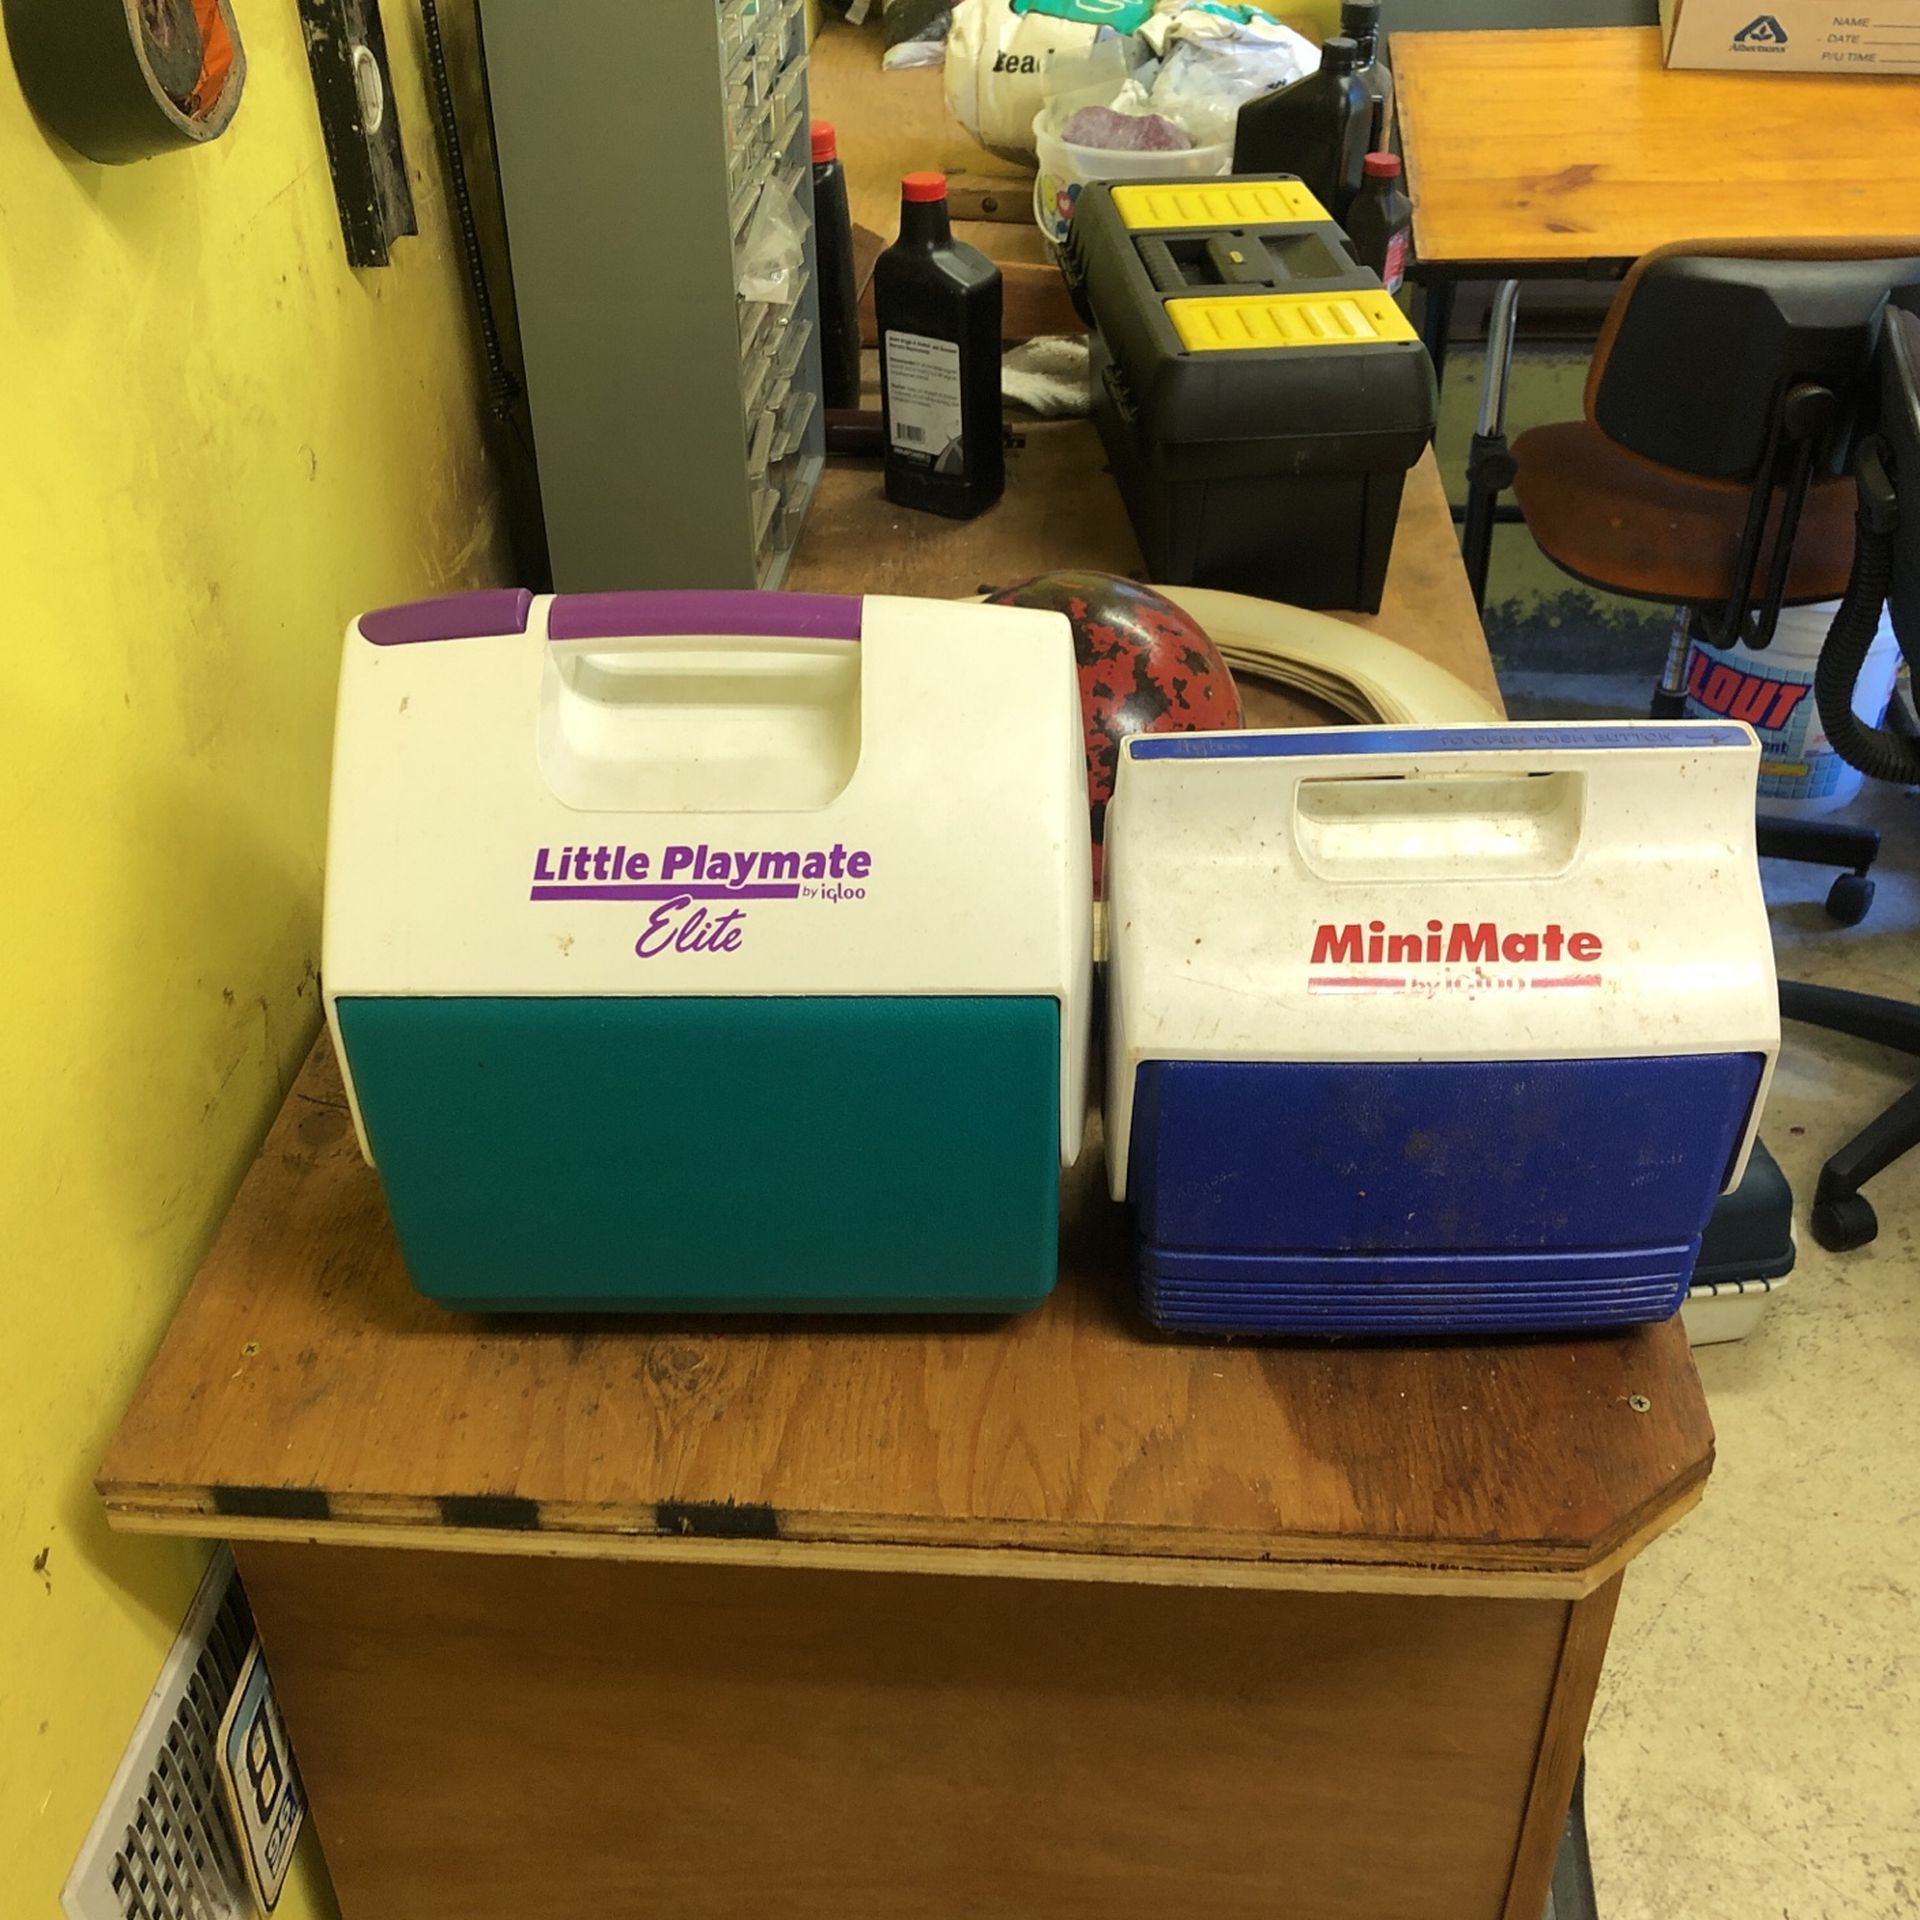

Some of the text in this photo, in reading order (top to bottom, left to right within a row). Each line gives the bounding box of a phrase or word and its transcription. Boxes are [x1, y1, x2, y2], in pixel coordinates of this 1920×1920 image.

[1832, 17, 1871, 28] NAME
[1826, 34, 1861, 44] DATE
[1848, 53, 1877, 64] TIME
[1688, 648, 1811, 731] LOUT
[534, 844, 872, 887] Little Playmate
[802, 883, 866, 904] by igloo
[634, 896, 747, 958] Elite
[1310, 920, 1602, 963] MiniMate
